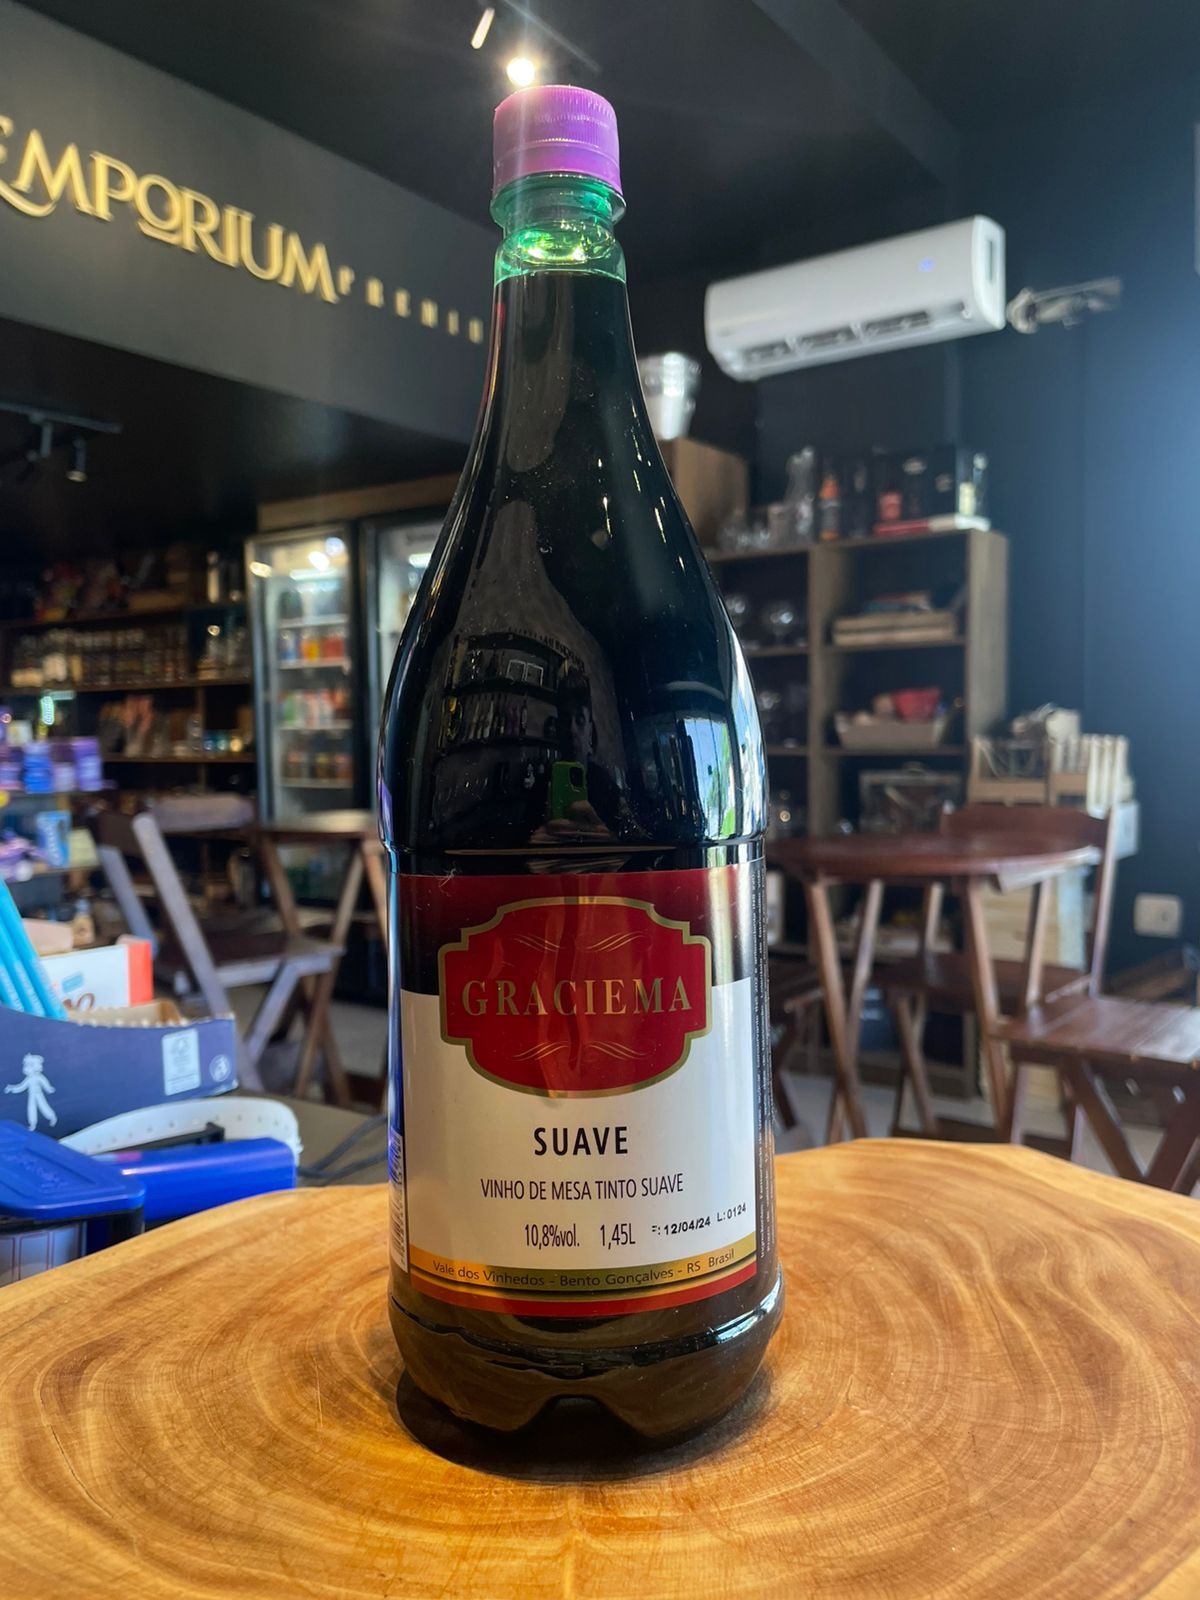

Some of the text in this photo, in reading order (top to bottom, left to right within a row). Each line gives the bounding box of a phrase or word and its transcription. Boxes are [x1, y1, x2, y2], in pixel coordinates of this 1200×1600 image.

[462, 975, 693, 1017] GRACIEMA
[533, 1126, 629, 1156] SUAVE
[480, 1172, 684, 1201] VINHO DE MESA TINTO SUAVE
[524, 1222, 637, 1251] 10,8%vol. 1,45L
[432, 1260, 455, 1276] Vale
[457, 1267, 480, 1281] dos
[482, 1270, 545, 1287] Vinhedos
[559, 1275, 601, 1287] Bento
[605, 1269, 674, 1285] Gonçalves
[686, 1260, 702, 1274] RS
[707, 1247, 736, 1268] Brasil
